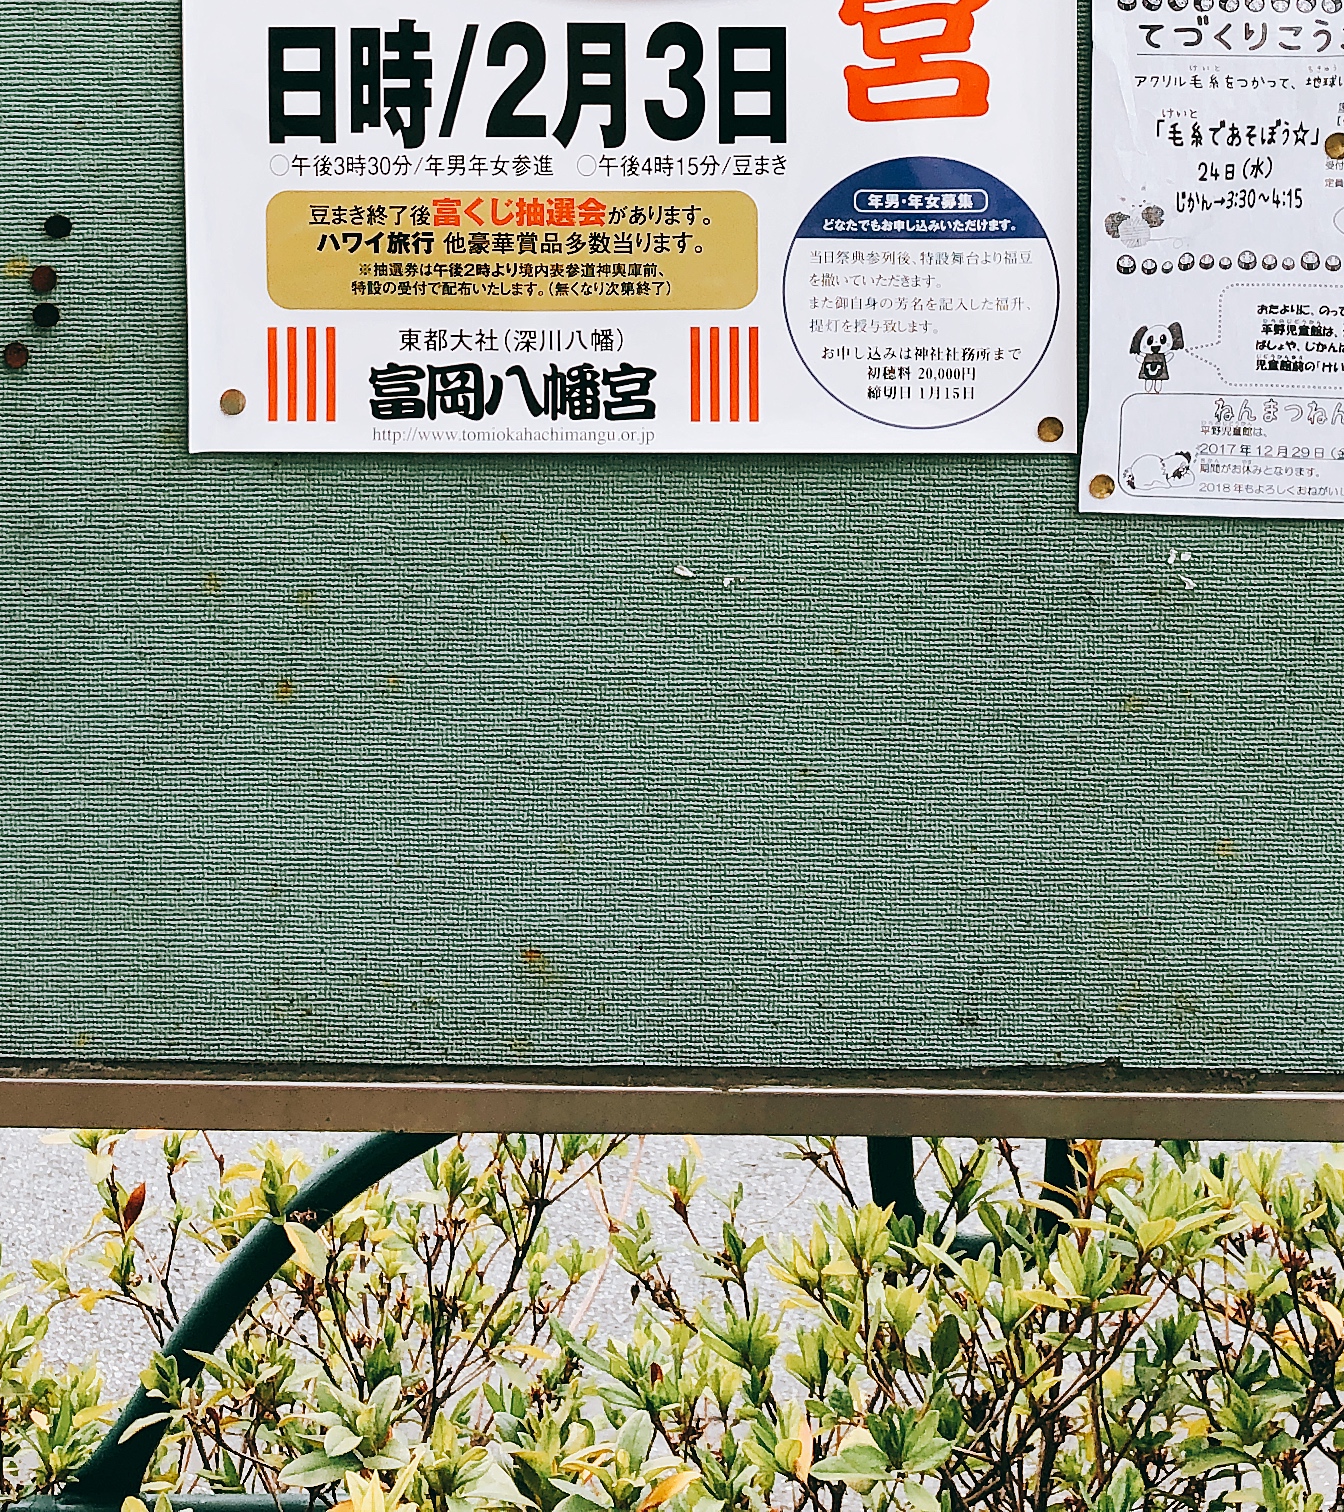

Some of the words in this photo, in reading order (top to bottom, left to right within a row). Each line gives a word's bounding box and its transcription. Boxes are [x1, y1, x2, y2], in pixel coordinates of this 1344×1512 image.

[268, 19, 787, 149] 日時/2月3日
[868, 193, 973, 209] 年男・年女募集
[309, 197, 712, 227] 豆まき終了後富くじ抽選会があります。
[823, 218, 1016, 232] どなたでもお申し込みいただけます。
[317, 232, 435, 255] ハワイ旅行
[444, 232, 704, 255] 他豪華賞品多数当ります。
[399, 327, 625, 353] 東都大社(深川八幡)
[867, 366, 911, 381] 初穂料
[918, 367, 976, 381] 20,000円
[369, 362, 656, 422] 富岡八幡宮
[867, 386, 911, 400] 締切日
[920, 387, 974, 400] 1月15日
[372, 427, 655, 446] http://www.tomiokahachimangu.or.jp
